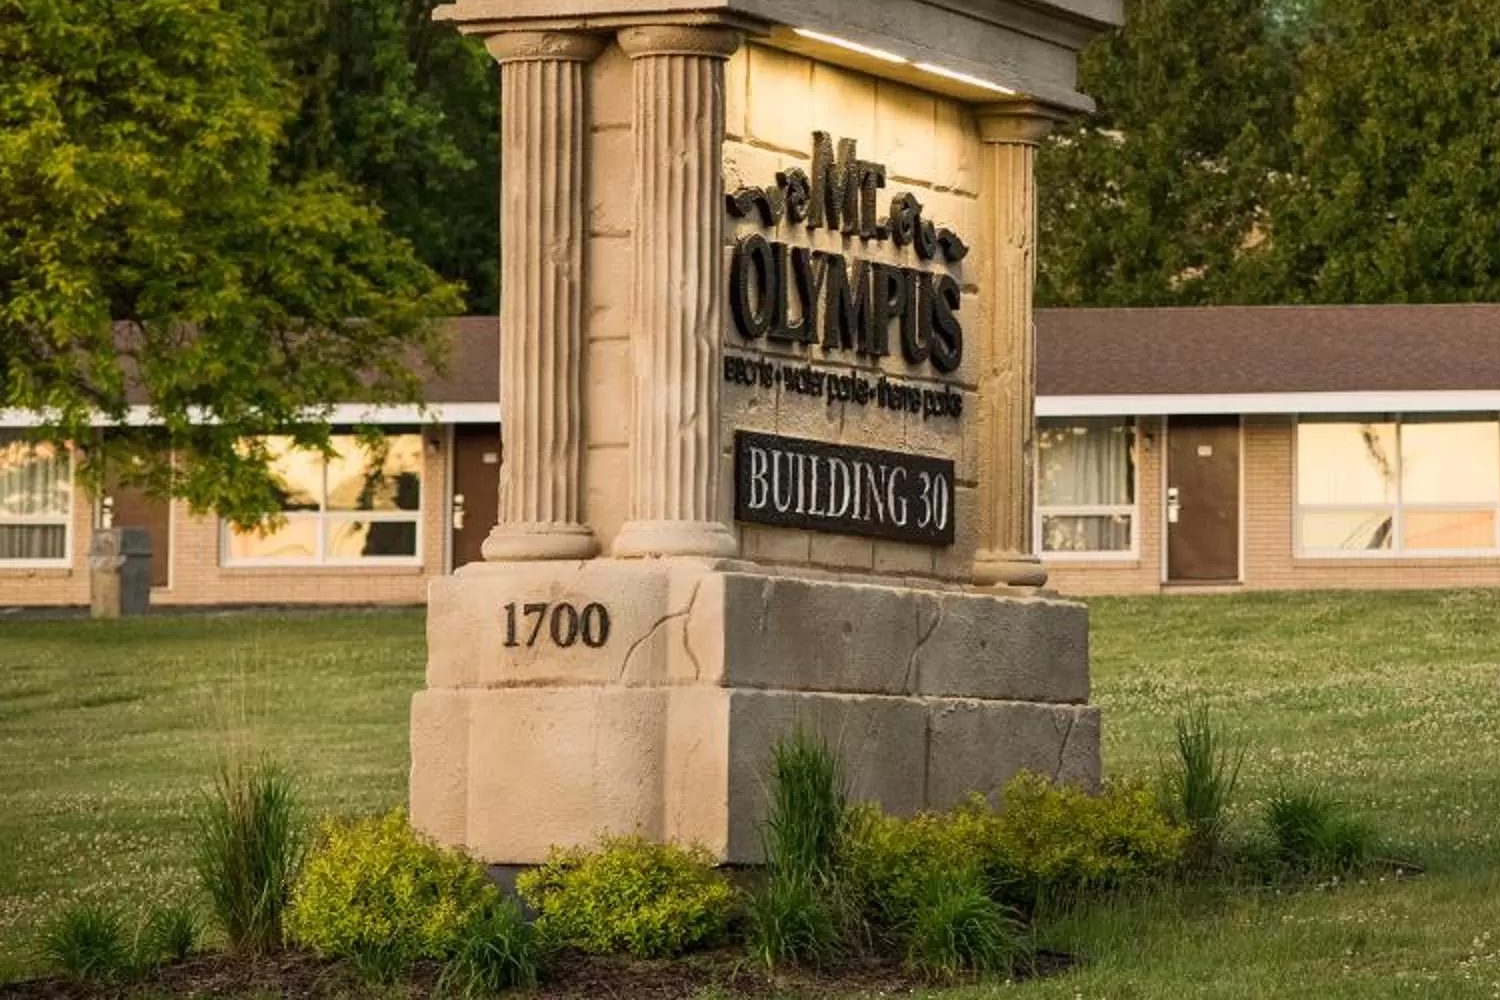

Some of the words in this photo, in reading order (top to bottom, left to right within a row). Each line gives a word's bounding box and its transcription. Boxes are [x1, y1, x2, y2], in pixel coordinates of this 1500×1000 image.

[730, 234, 962, 373] OLYMPUS
[749, 448, 907, 526] BUILDING
[917, 471, 949, 531] 30
[503, 602, 611, 648] 1700
